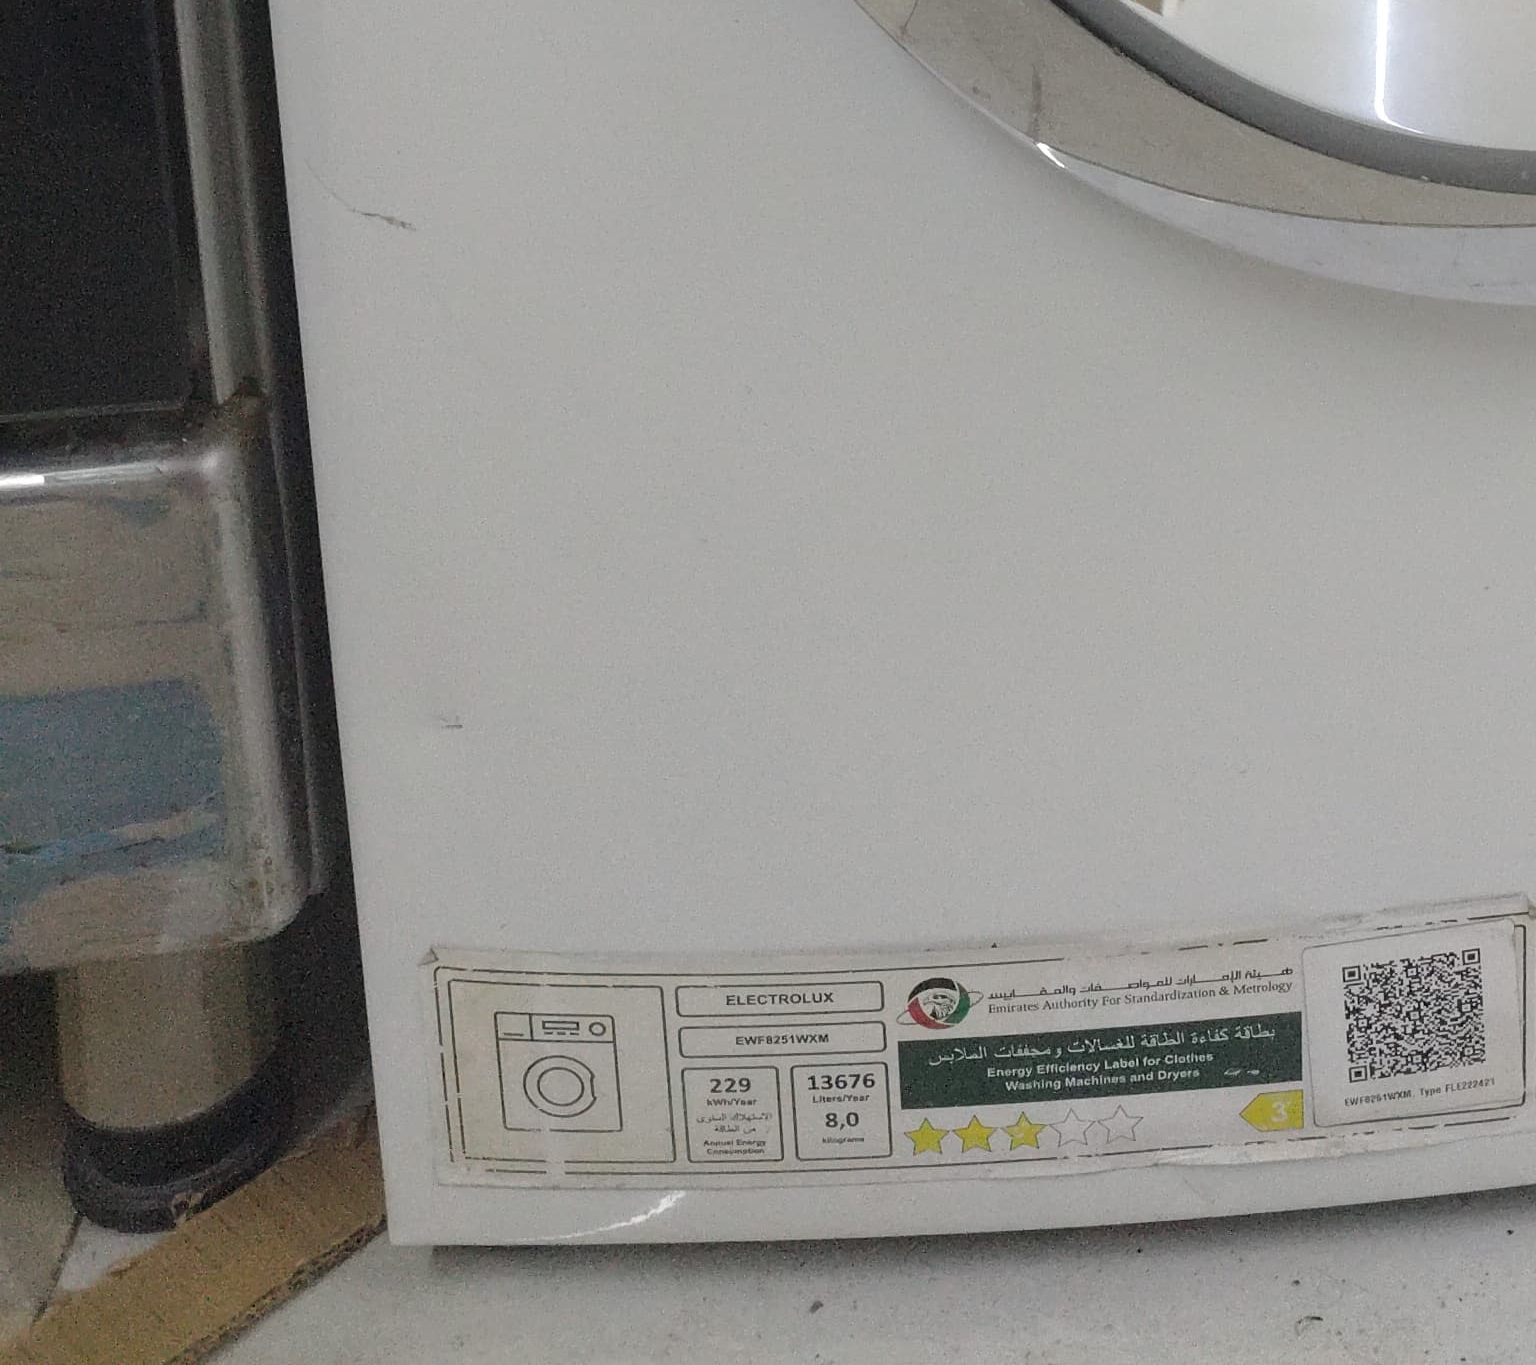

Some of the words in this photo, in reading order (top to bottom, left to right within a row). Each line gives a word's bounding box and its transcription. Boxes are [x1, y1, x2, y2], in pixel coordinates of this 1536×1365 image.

[726, 992, 834, 1006] ELECTROLUX
[988, 1001, 1039, 1014] Emirates
[1042, 997, 1098, 1013] Authority
[1102, 995, 1121, 1007] For
[1124, 988, 1216, 1005] Standardization
[1219, 986, 1230, 996] &
[1234, 980, 1293, 996] Metrology
[735, 1034, 830, 1046] EWF8251WXM
[987, 1065, 1033, 1079] Energy
[1036, 1061, 1100, 1076] Efficiency
[1104, 1057, 1139, 1070] Label
[1143, 1055, 1161, 1067] for
[1165, 1052, 1214, 1065] Clothes
[709, 1078, 751, 1094] 229
[807, 1073, 876, 1090] 13676
[1005, 1078, 1061, 1092] Washing
[1065, 1074, 1126, 1087] Machines
[1130, 1071, 1153, 1083] and
[1158, 1068, 1200, 1082] Dryers
[812, 1094, 870, 1104] Liters/Year
[1420, 1086, 1442, 1098] Type
[825, 1112, 859, 1130] 8,0
